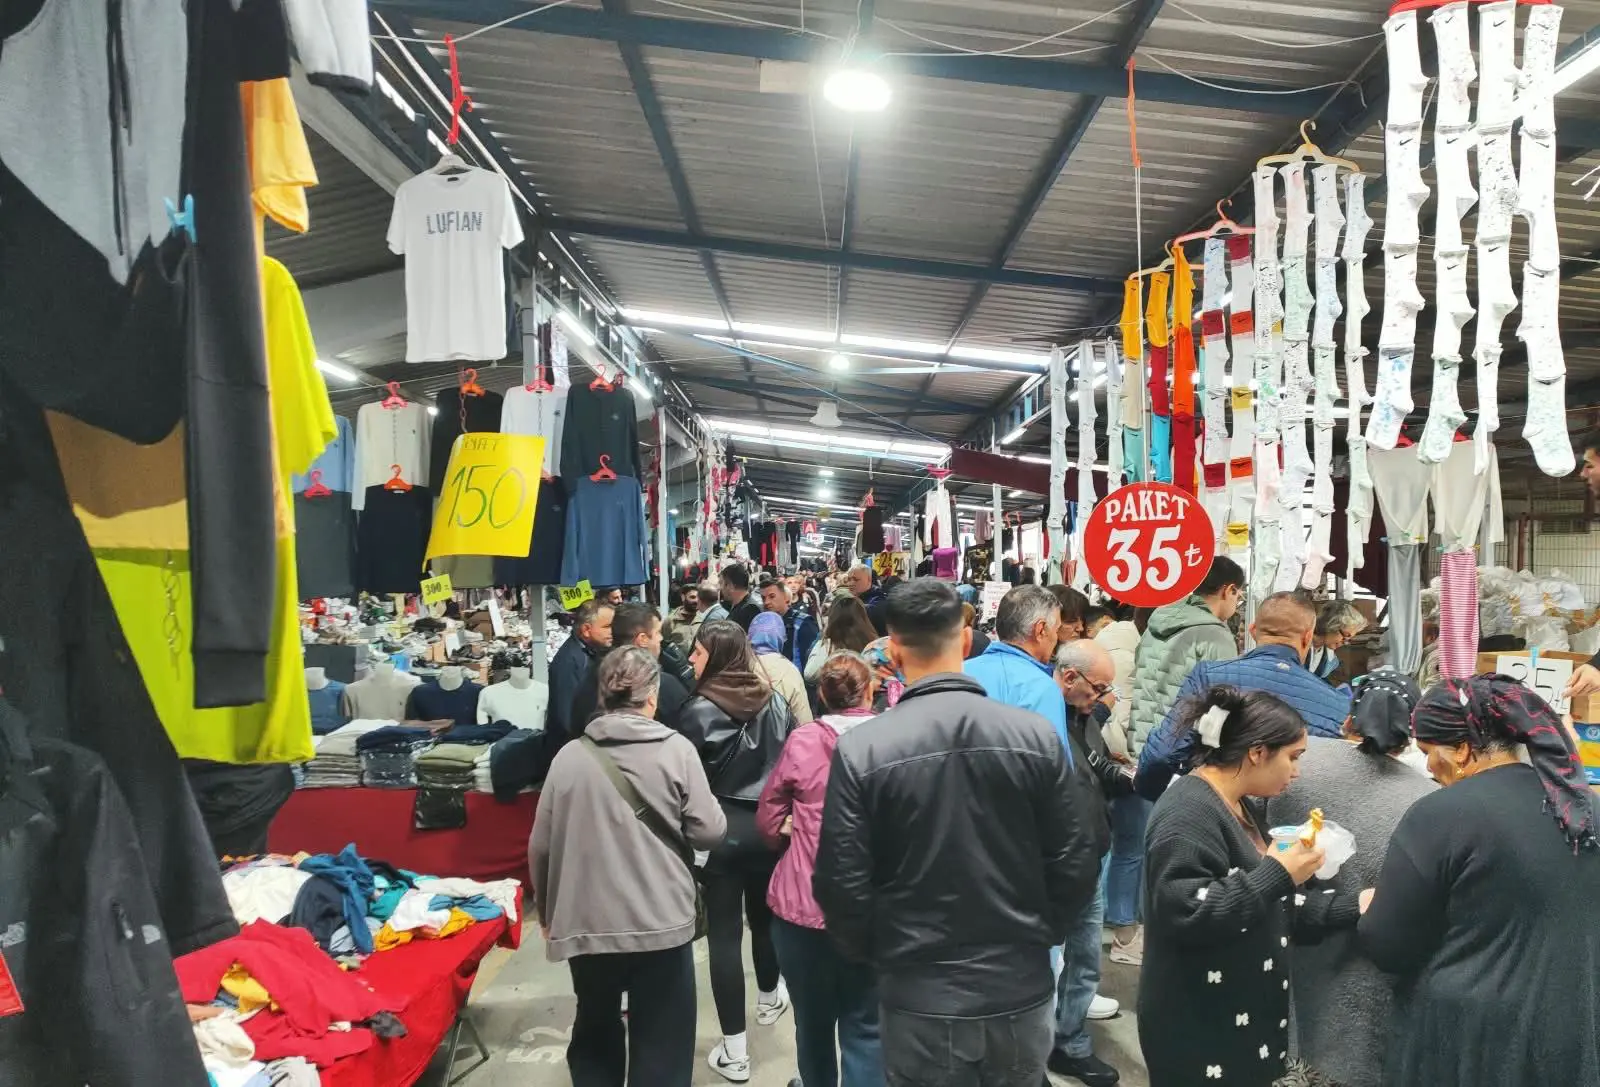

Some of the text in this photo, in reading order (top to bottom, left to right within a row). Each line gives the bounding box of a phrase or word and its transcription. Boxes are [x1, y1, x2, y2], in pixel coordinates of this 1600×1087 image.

[426, 210, 482, 234] LUFIAN
[448, 464, 526, 529] 150
[1105, 490, 1190, 523] PAKET
[424, 582, 441, 596] 300
[563, 587, 582, 601] 300
